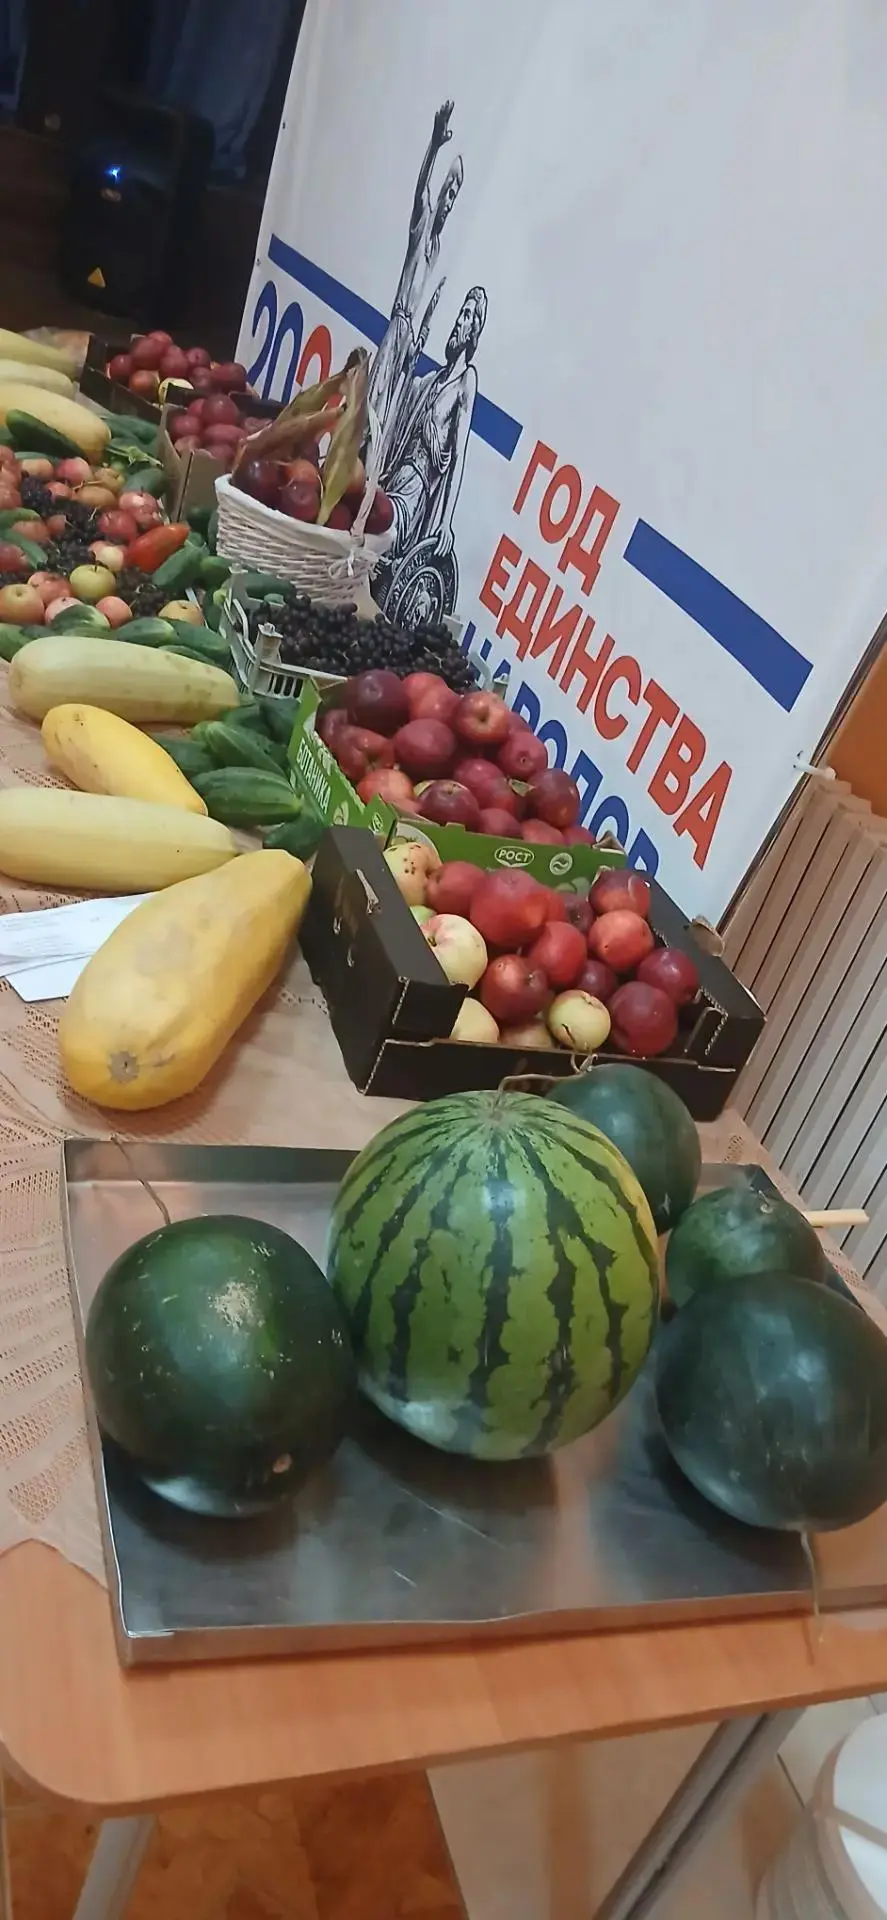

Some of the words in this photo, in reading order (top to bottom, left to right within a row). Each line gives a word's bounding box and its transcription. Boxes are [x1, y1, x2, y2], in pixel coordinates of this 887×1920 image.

[240, 280, 342, 428] 202
[513, 440, 621, 597] ГОД
[296, 737, 331, 815] БОТАНИКА
[480, 533, 733, 871] ЕДИНСТВА
[498, 849, 533, 863] РОСТ
